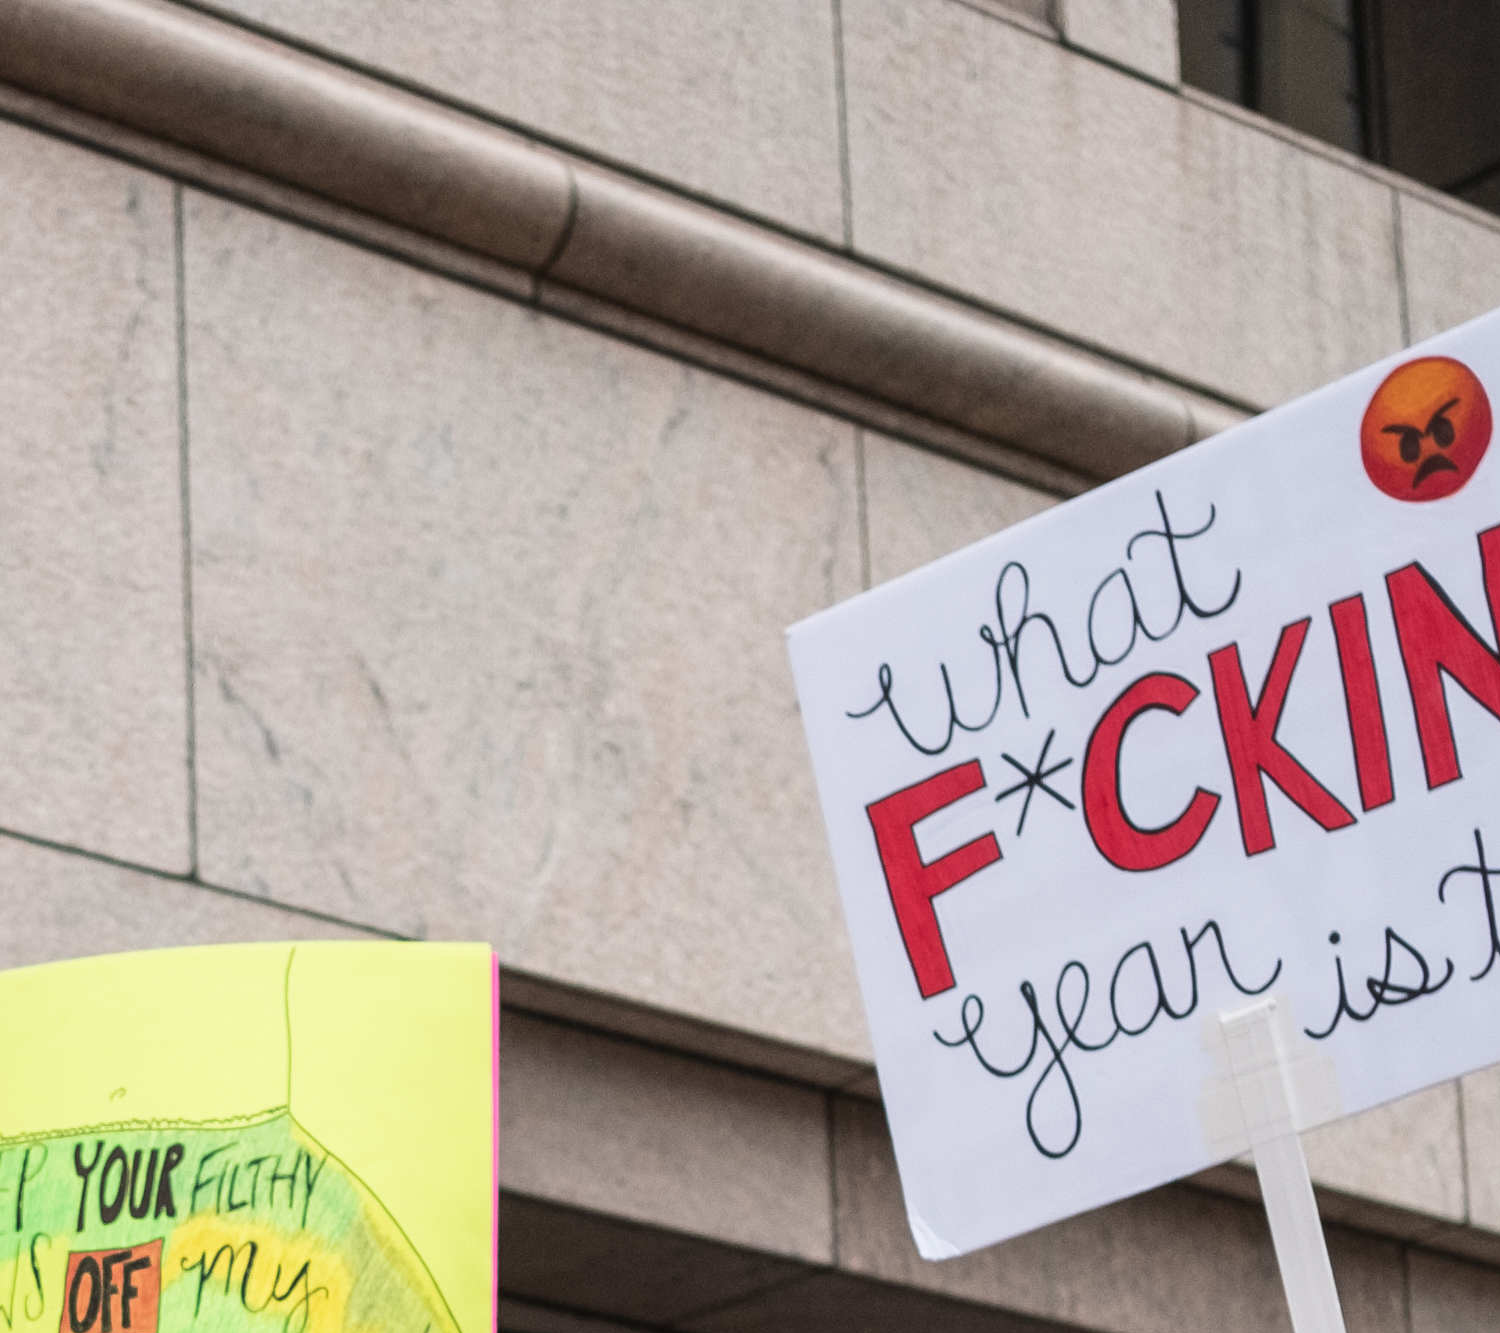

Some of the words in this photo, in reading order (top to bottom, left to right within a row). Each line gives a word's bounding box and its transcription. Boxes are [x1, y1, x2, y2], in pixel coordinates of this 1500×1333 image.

[847, 490, 1240, 755] what
[933, 920, 1281, 1159] year
[1305, 931, 1453, 1039] is
[74, 1140, 184, 1233] YOUR
[190, 1142, 328, 1229] FILTHY
